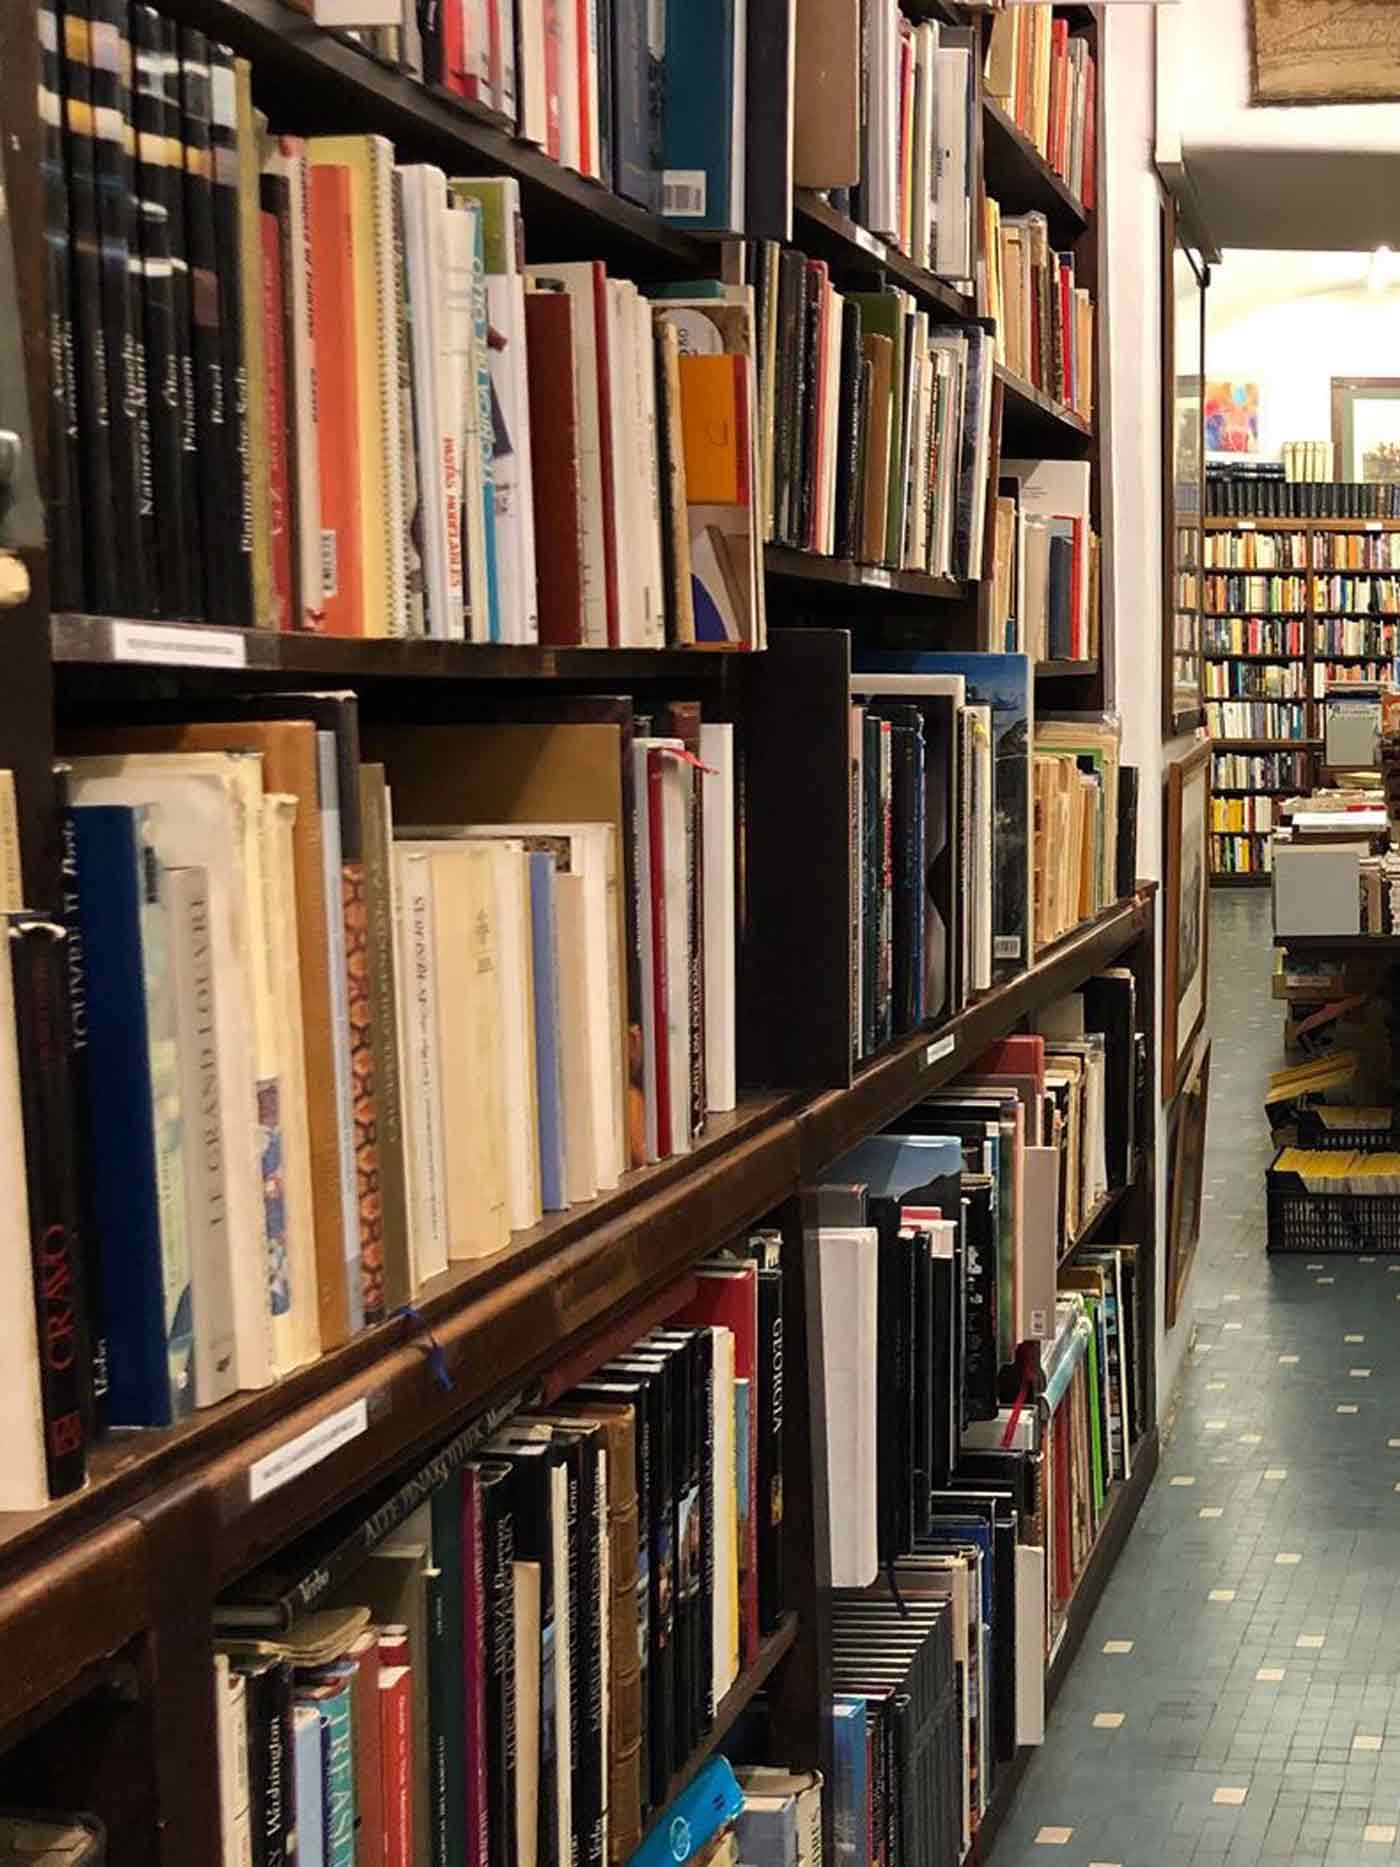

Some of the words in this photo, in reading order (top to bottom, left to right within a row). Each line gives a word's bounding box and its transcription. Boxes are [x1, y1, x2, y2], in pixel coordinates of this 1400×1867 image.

[137, 419, 156, 515] Natureza
[442, 436, 458, 489] PASTAS
[39, 1223, 74, 1370] CRAVO
[771, 1317, 784, 1434] GEORGIA
[265, 1714, 283, 1837] Washington
